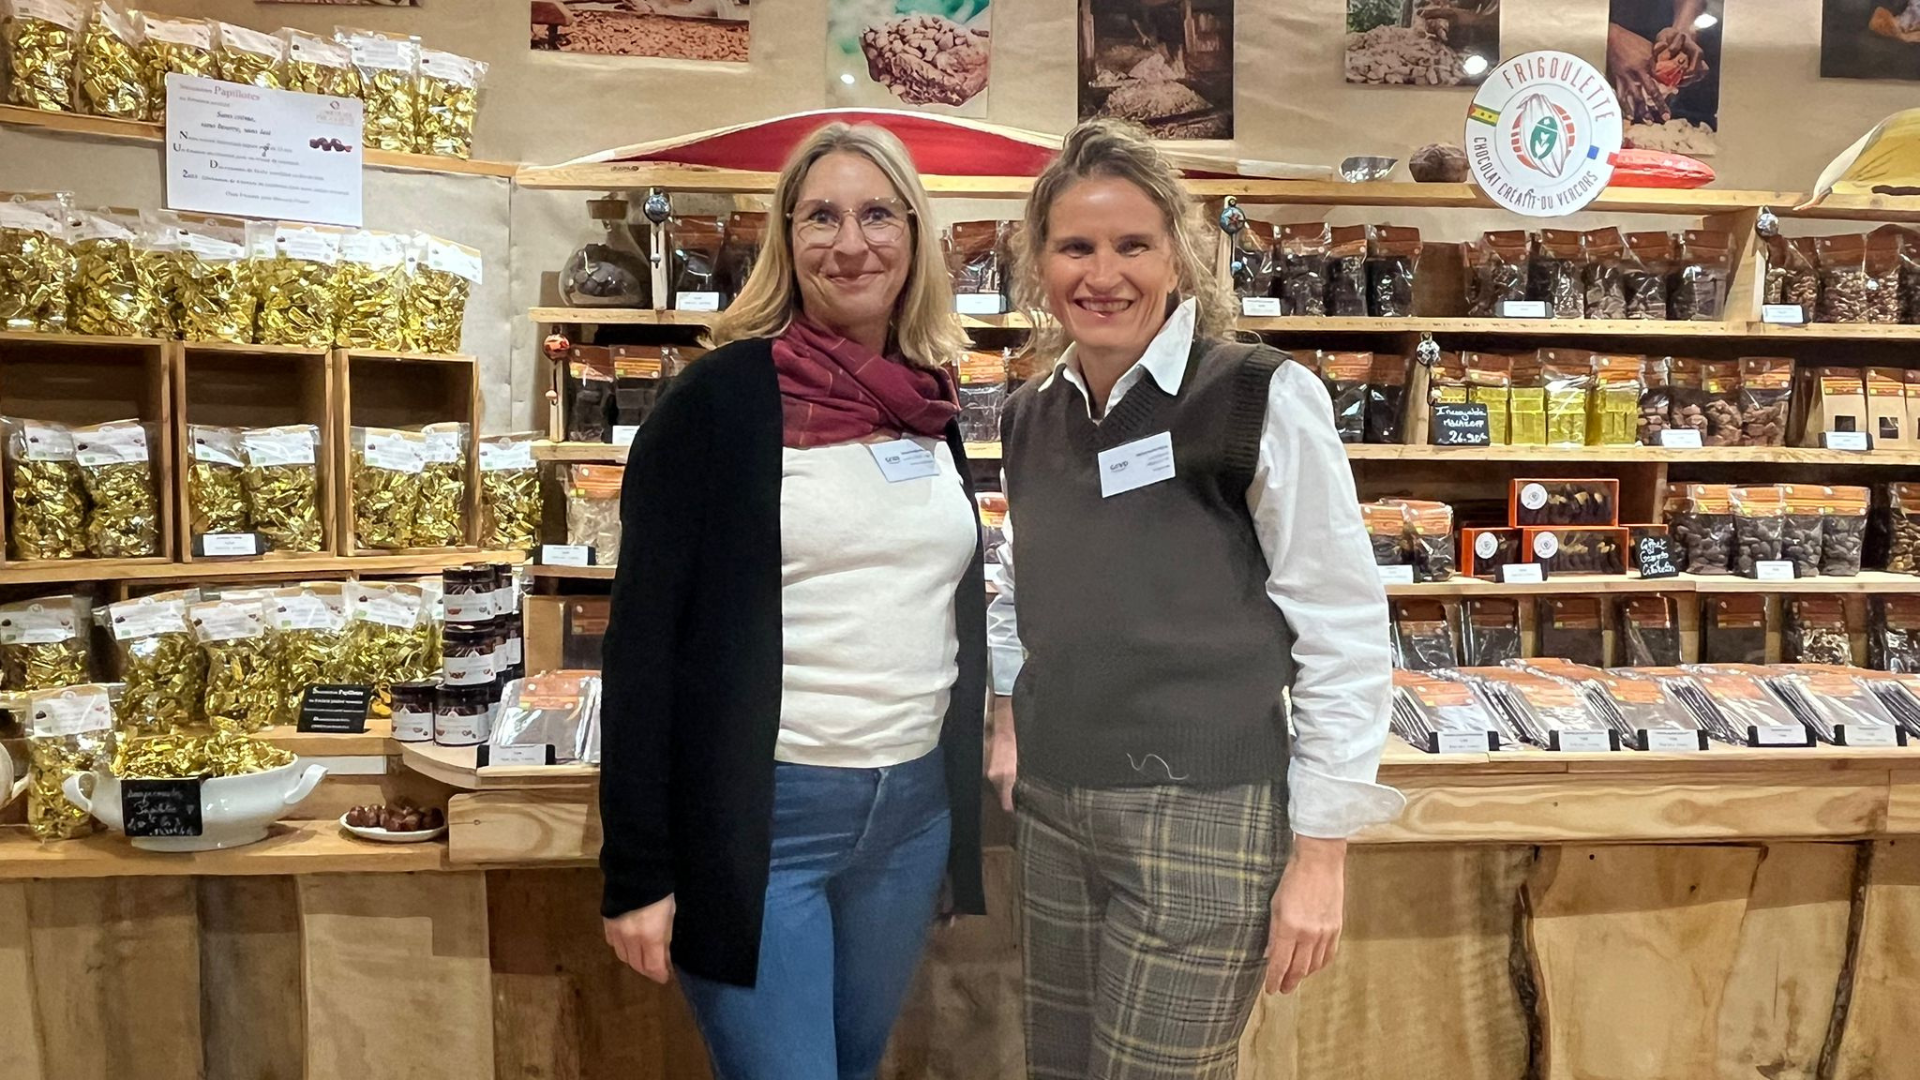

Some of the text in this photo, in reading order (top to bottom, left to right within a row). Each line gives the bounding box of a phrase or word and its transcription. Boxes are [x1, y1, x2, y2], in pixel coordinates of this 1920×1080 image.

[214, 85, 260, 100] Papillotes
[1502, 57, 1614, 122] FRIGOULETTE
[1474, 137, 1501, 187] CHOCOLAT
[1541, 195, 1554, 210] DU
[1556, 170, 1599, 206] VERCORS
